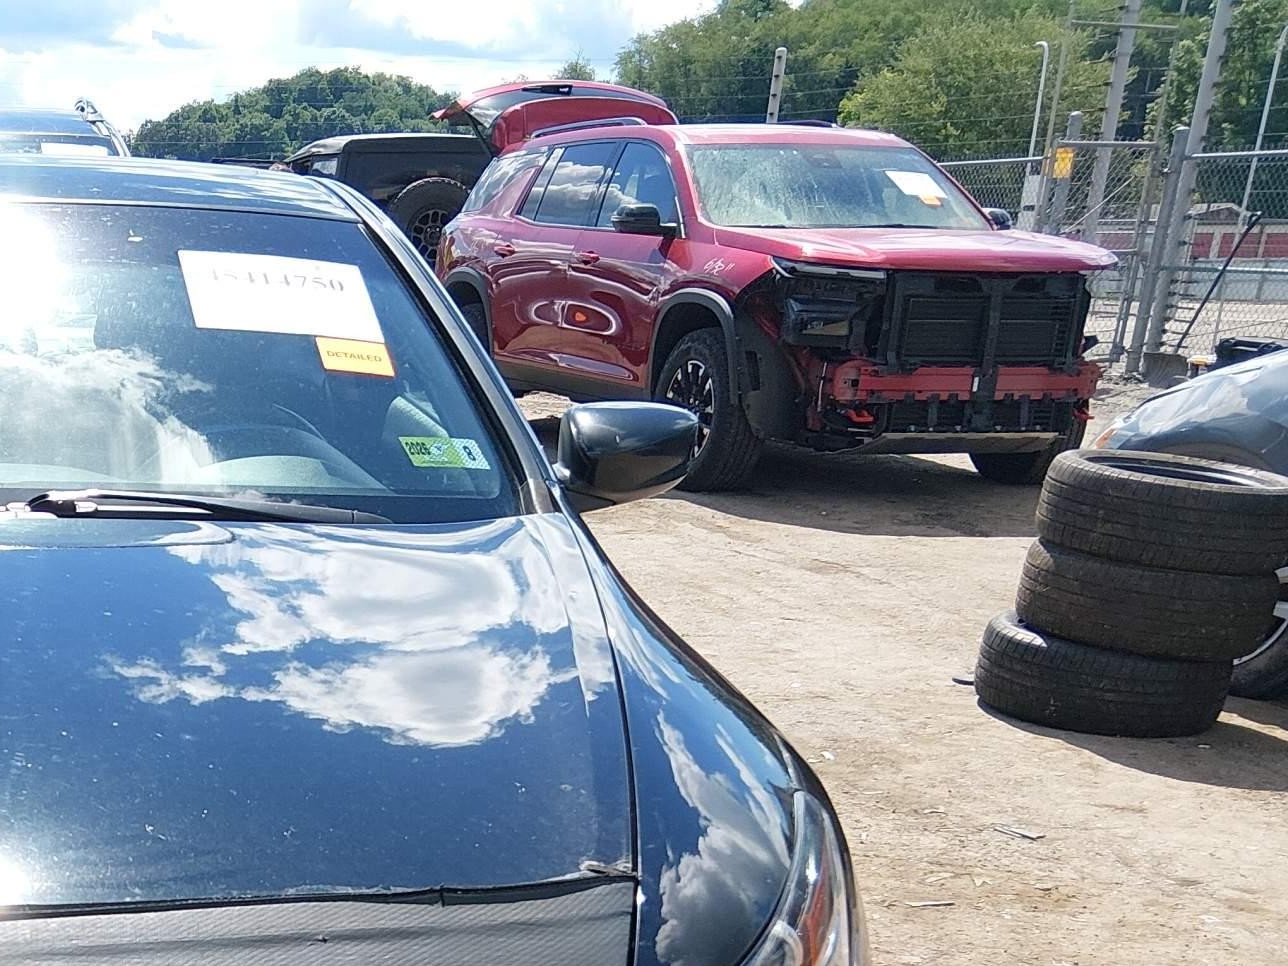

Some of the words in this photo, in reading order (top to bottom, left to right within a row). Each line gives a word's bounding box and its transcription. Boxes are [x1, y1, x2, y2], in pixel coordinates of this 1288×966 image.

[326, 350, 382, 363] DETAILED
[404, 441, 432, 456] 2026
[462, 444, 477, 462] 8
